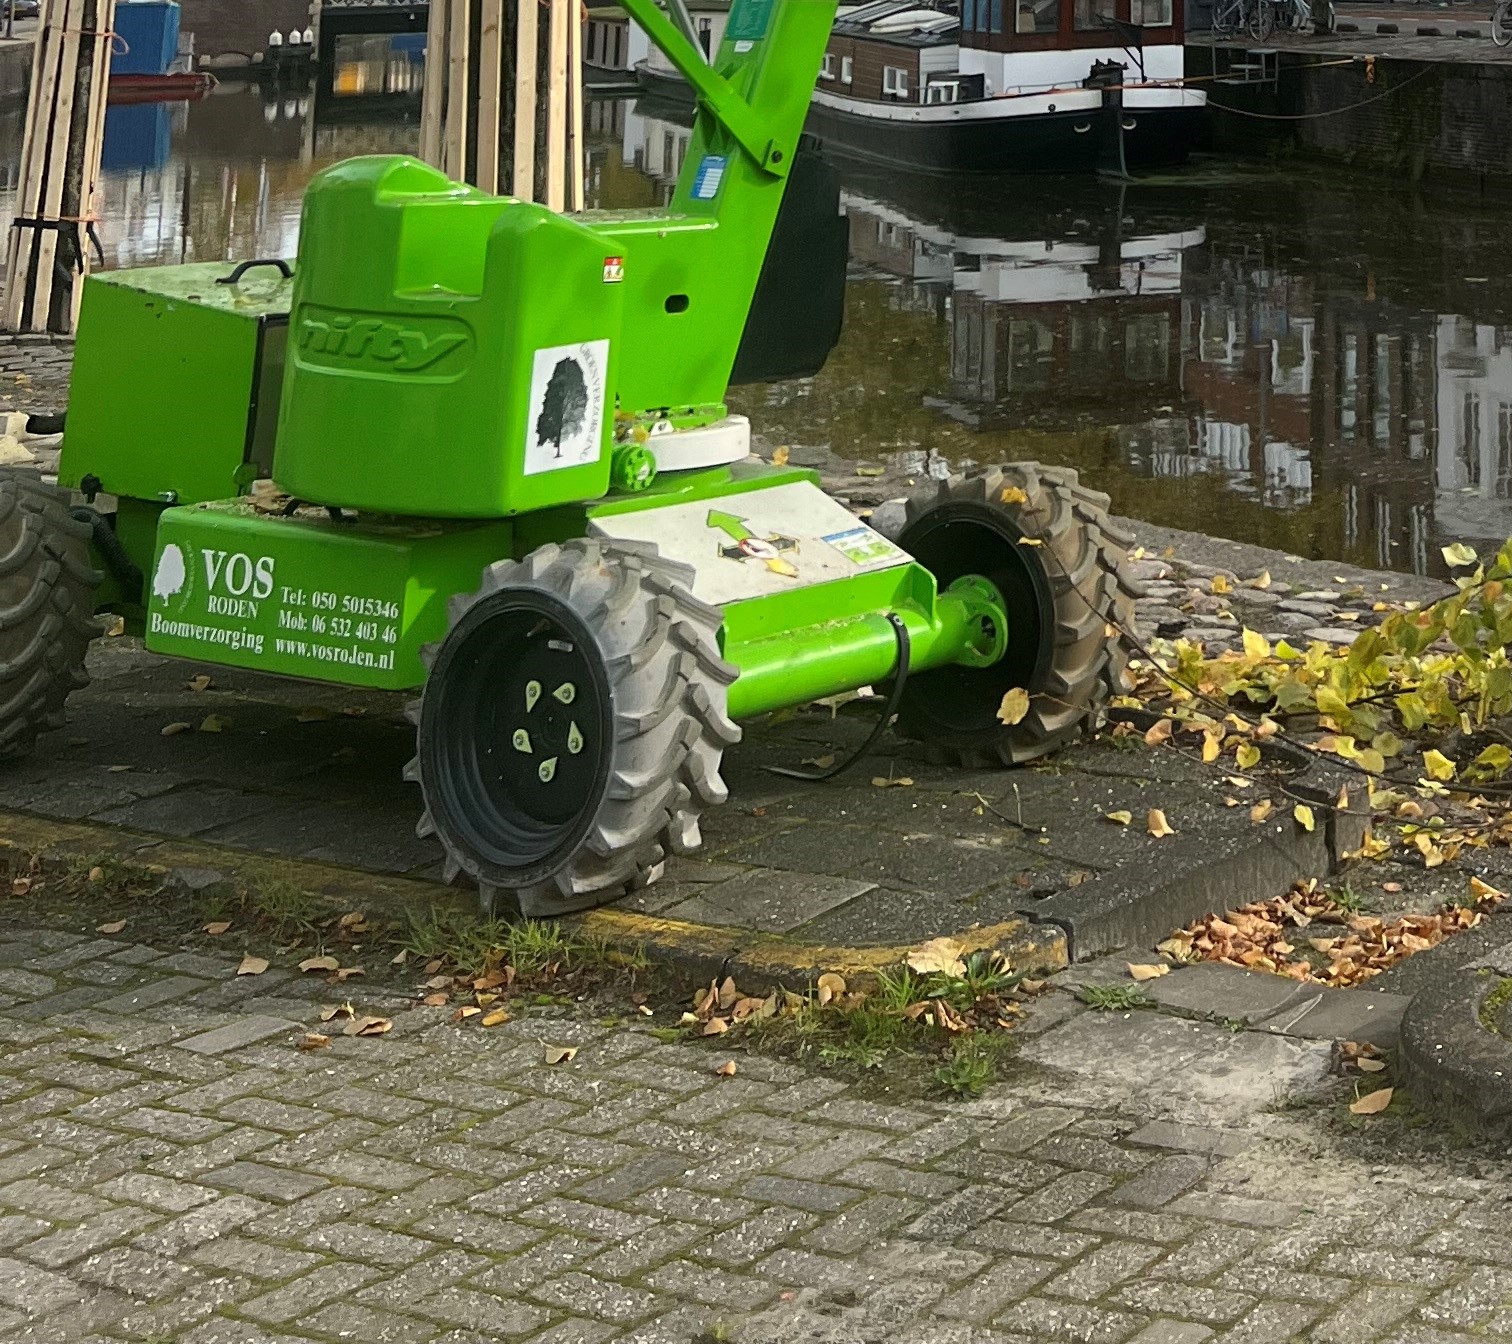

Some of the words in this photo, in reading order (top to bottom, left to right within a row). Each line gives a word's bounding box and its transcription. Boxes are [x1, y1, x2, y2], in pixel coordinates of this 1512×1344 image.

[301, 316, 467, 372] nifty
[201, 548, 275, 599] VOS
[207, 595, 260, 620] RODEN
[281, 586, 307, 606] Tel:
[312, 591, 337, 611] 050
[342, 595, 399, 619] 5015346
[151, 612, 265, 655] Boomverzorging
[278, 610, 308, 630] Mob:
[312, 614, 326, 634] 06
[330, 617, 351, 638] 532
[355, 621, 378, 642] 403
[382, 625, 397, 644] 46
[275, 637, 395, 670] www.vosroden.nl
